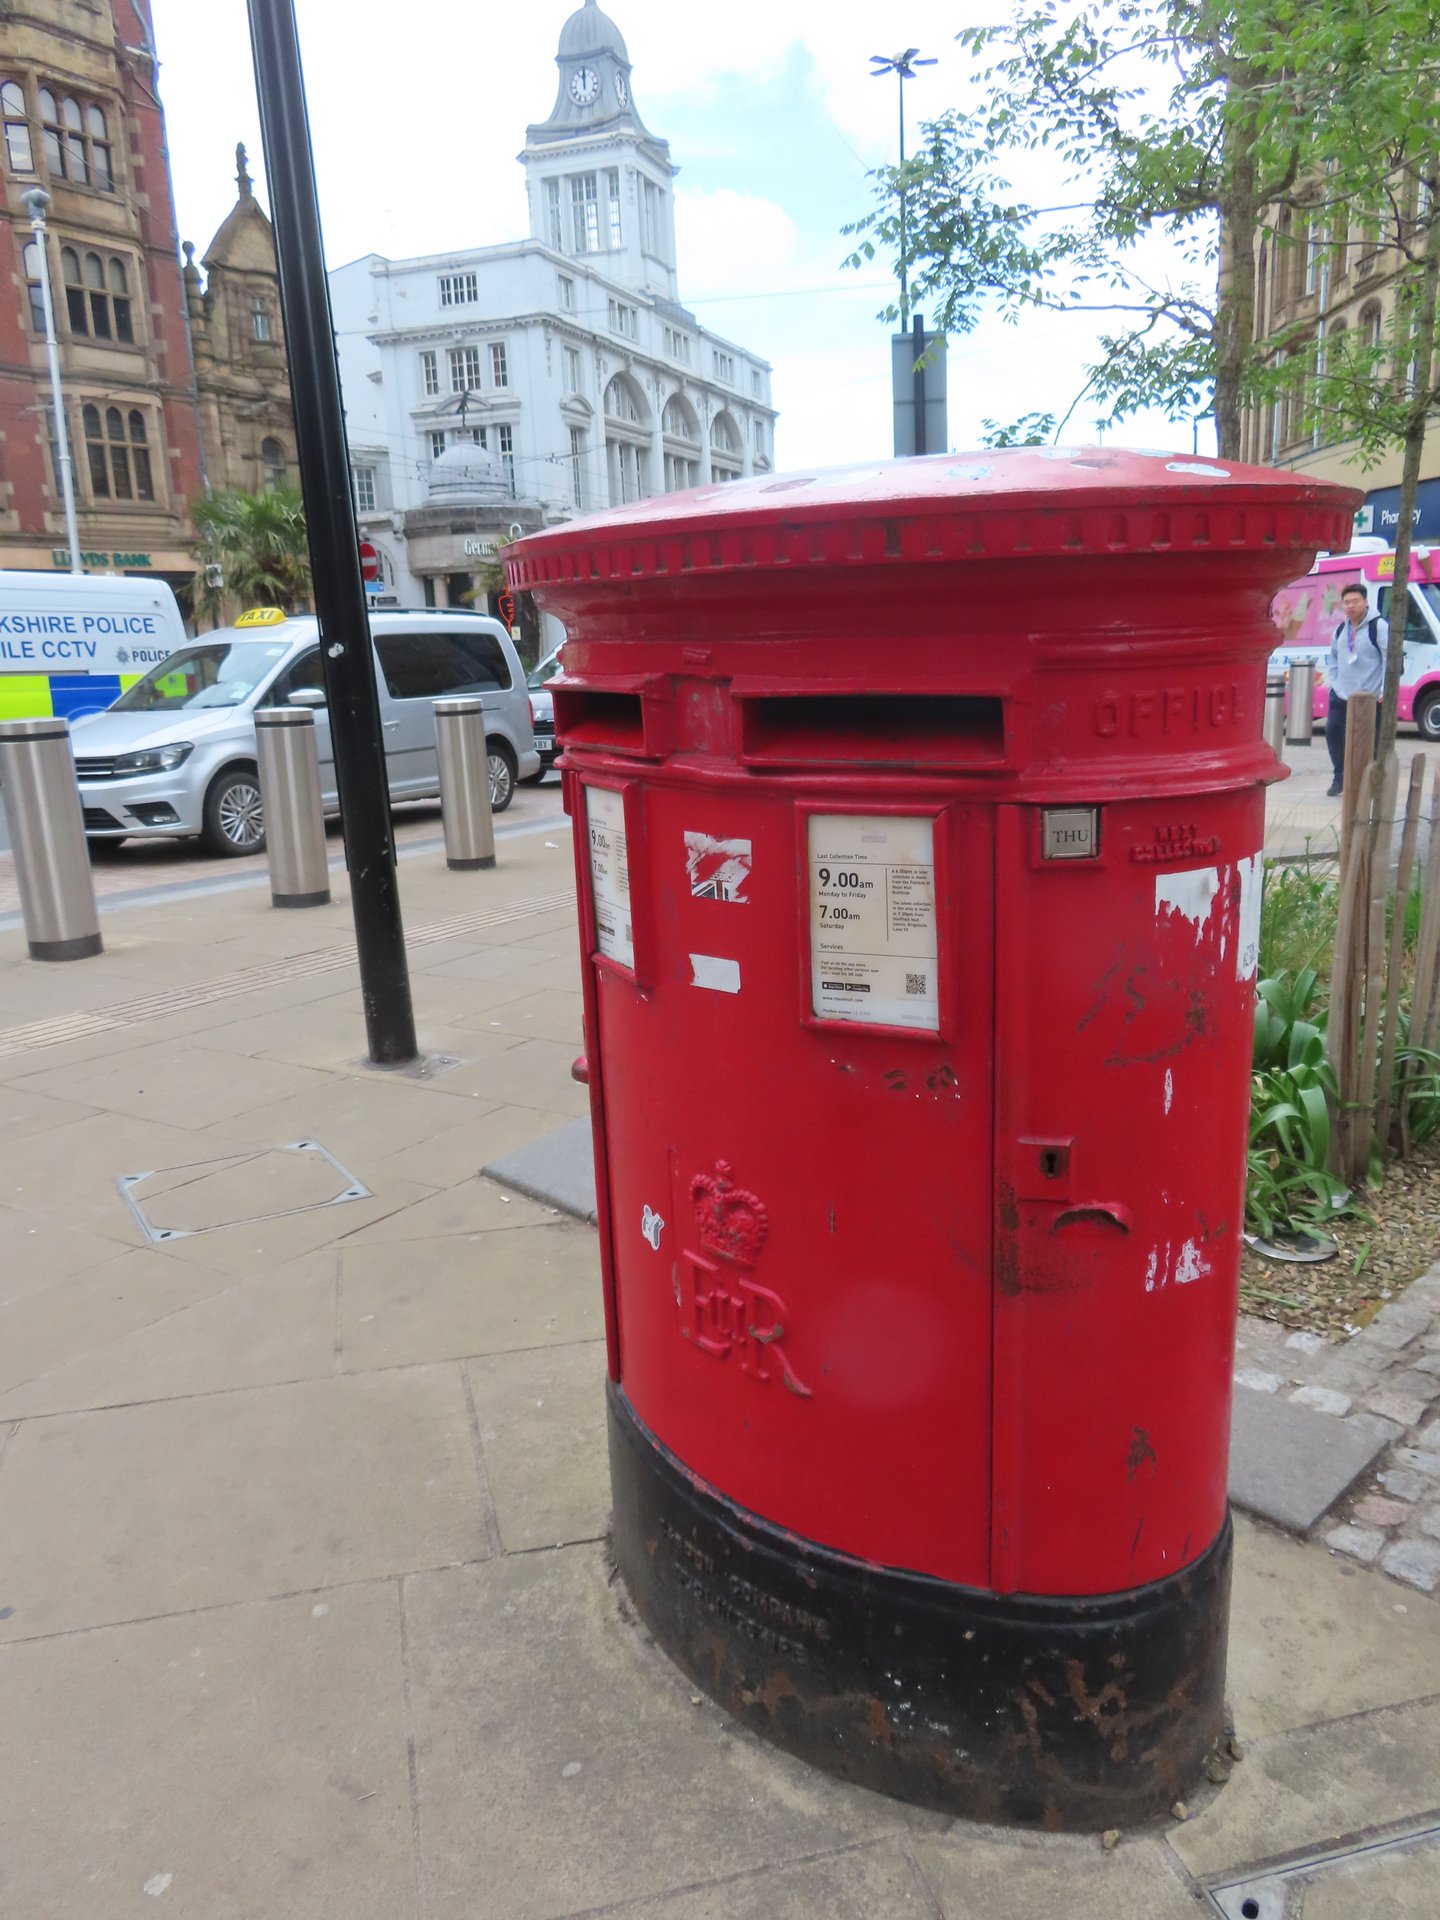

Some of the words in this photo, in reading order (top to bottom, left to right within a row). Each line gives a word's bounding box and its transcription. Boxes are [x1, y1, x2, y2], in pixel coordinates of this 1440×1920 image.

[1381, 509, 1421, 525] Pharcy
[53, 550, 109, 567] LLYDS
[112, 552, 152, 568] BANK
[241, 610, 275, 622] TAXI
[0, 616, 77, 634] KSHIRE
[83, 616, 156, 634] POLICE
[42, 641, 97, 658] CCTV
[132, 650, 171, 662] POLICE
[1092, 682, 1245, 738] OFFICE
[1052, 829, 1089, 843] THU
[818, 867, 874, 889] 9.00am
[818, 891, 840, 899] Monday
[848, 891, 867, 899] Friday
[819, 904, 861, 920] 7.00am
